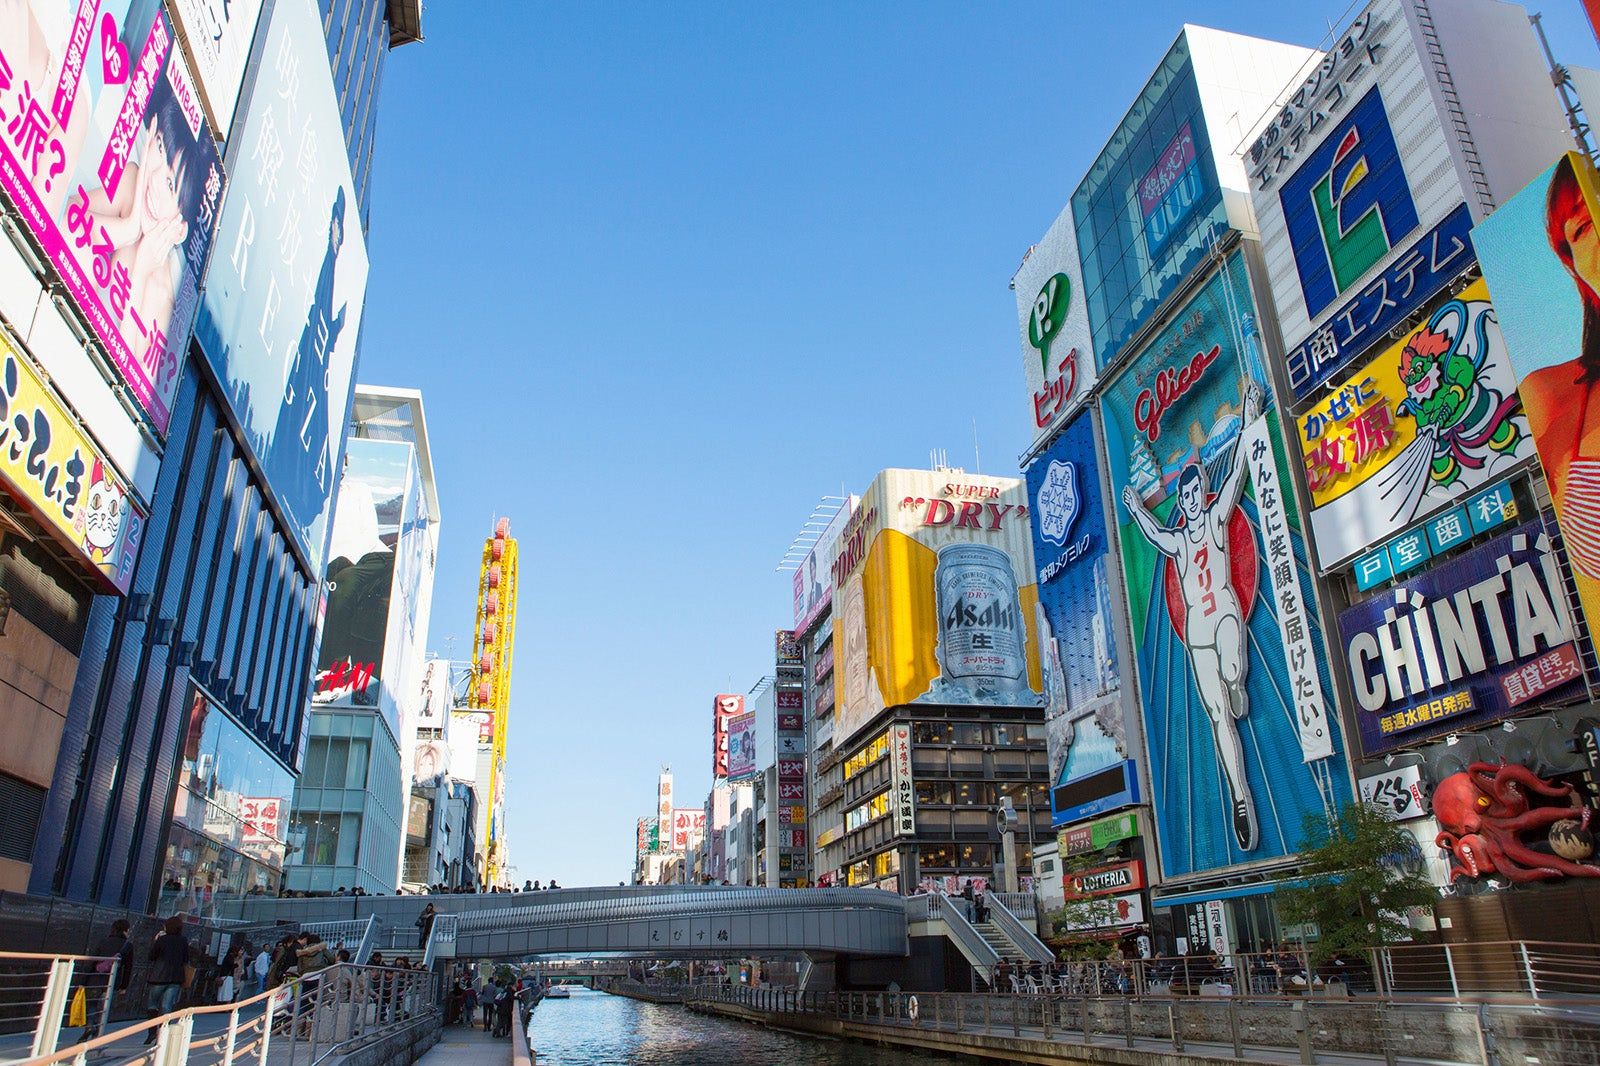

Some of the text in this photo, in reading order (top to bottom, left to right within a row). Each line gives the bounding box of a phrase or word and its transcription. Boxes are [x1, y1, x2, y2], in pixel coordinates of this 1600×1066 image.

[104, 34, 121, 78] VS
[105, 17, 168, 188] 写真集対決!
[170, 60, 200, 133] NMB48
[1250, 12, 1371, 167] 夢あるマンション
[1257, 43, 1381, 191] エステムコート
[67, 184, 178, 393] みるきー派?
[1286, 231, 1465, 389] 日商エステム
[230, 193, 333, 493] REGZA
[1033, 348, 1077, 429] ピップ
[1134, 344, 1221, 442] Glico
[1302, 377, 1378, 441] かぜに
[1302, 397, 1398, 495] 改源
[944, 483, 1000, 499] SUPER
[1504, 504, 1515, 518] 3F
[118, 518, 139, 581] 2F
[1039, 534, 1090, 585] 雪印メグミルク
[1361, 489, 1505, 583] 戸堂歯科
[1193, 541, 1217, 618] グリコ
[1252, 438, 1323, 737] みんなに笑顔を届けたい。
[947, 597, 1015, 631] Asahi
[963, 656, 1006, 664] スーパードライ
[972, 632, 993, 649] 生
[1539, 652, 1563, 674] 住宅
[319, 660, 376, 695] H&M
[1503, 664, 1545, 704] 賃貸
[1544, 660, 1580, 686] ニュース
[1379, 691, 1473, 734] 毎週水曜日発売
[1584, 732, 1599, 768] 2F
[1373, 776, 1412, 814] くくる
[676, 814, 706, 829] かに
[1083, 870, 1127, 890] LOTTERIA
[652, 928, 729, 942] えびす橋
